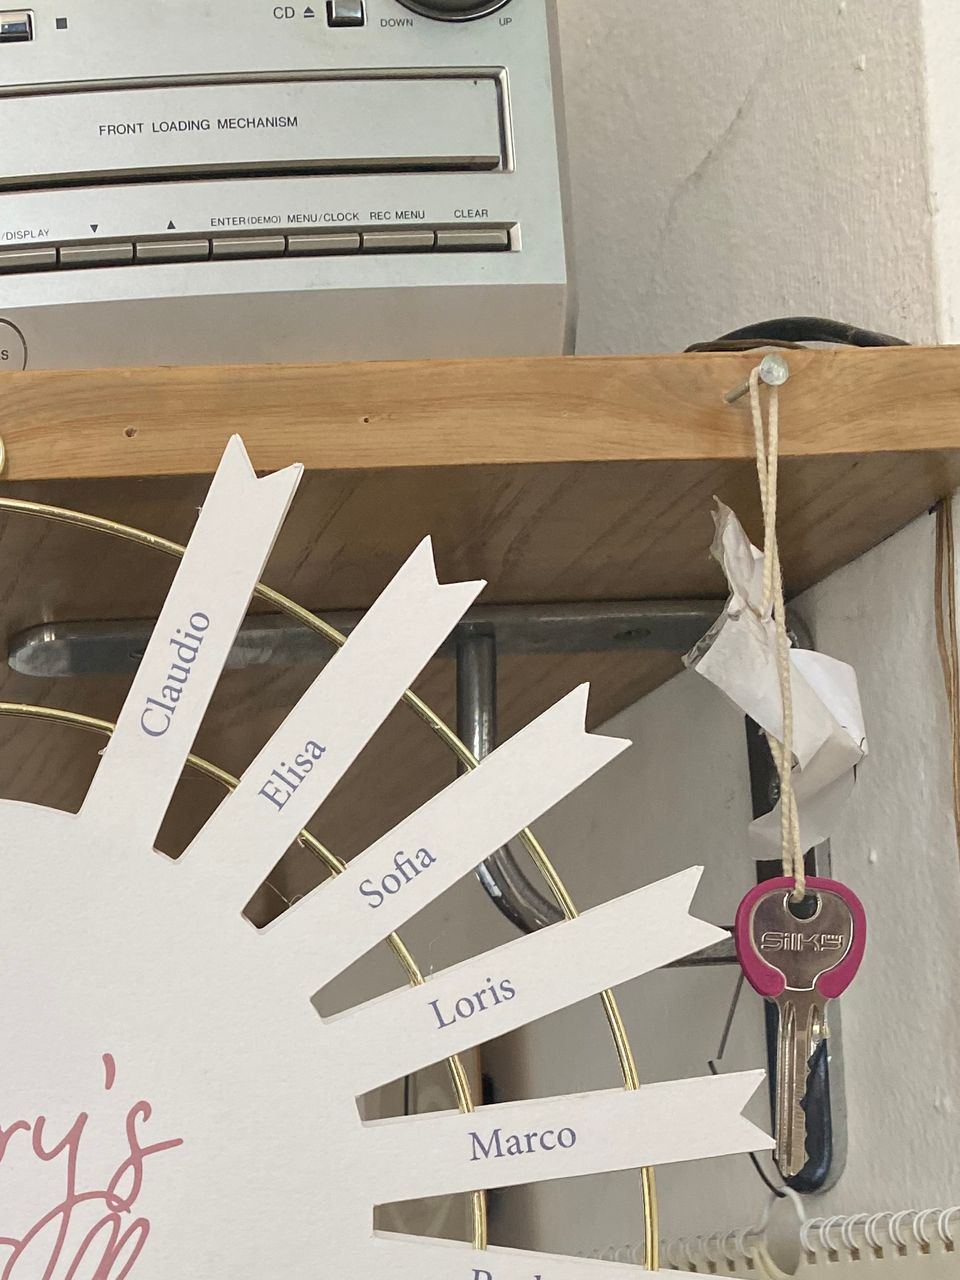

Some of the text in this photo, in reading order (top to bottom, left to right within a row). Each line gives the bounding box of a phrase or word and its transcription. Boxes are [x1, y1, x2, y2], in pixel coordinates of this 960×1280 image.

[273, 6, 295, 19] CD
[380, 18, 414, 28] DOWN
[499, 17, 513, 27] UP
[99, 116, 298, 136] FRONT LOADING MECHANISM
[287, 212, 360, 223] MENU/CLOCK
[369, 210, 426, 220] REC MENU
[453, 209, 489, 218] CLEAR
[140, 611, 211, 738] Claudio
[258, 739, 327, 812] Elisa
[358, 844, 437, 909] Sofia
[428, 976, 517, 1030] Loris
[469, 1127, 578, 1161] Marco
